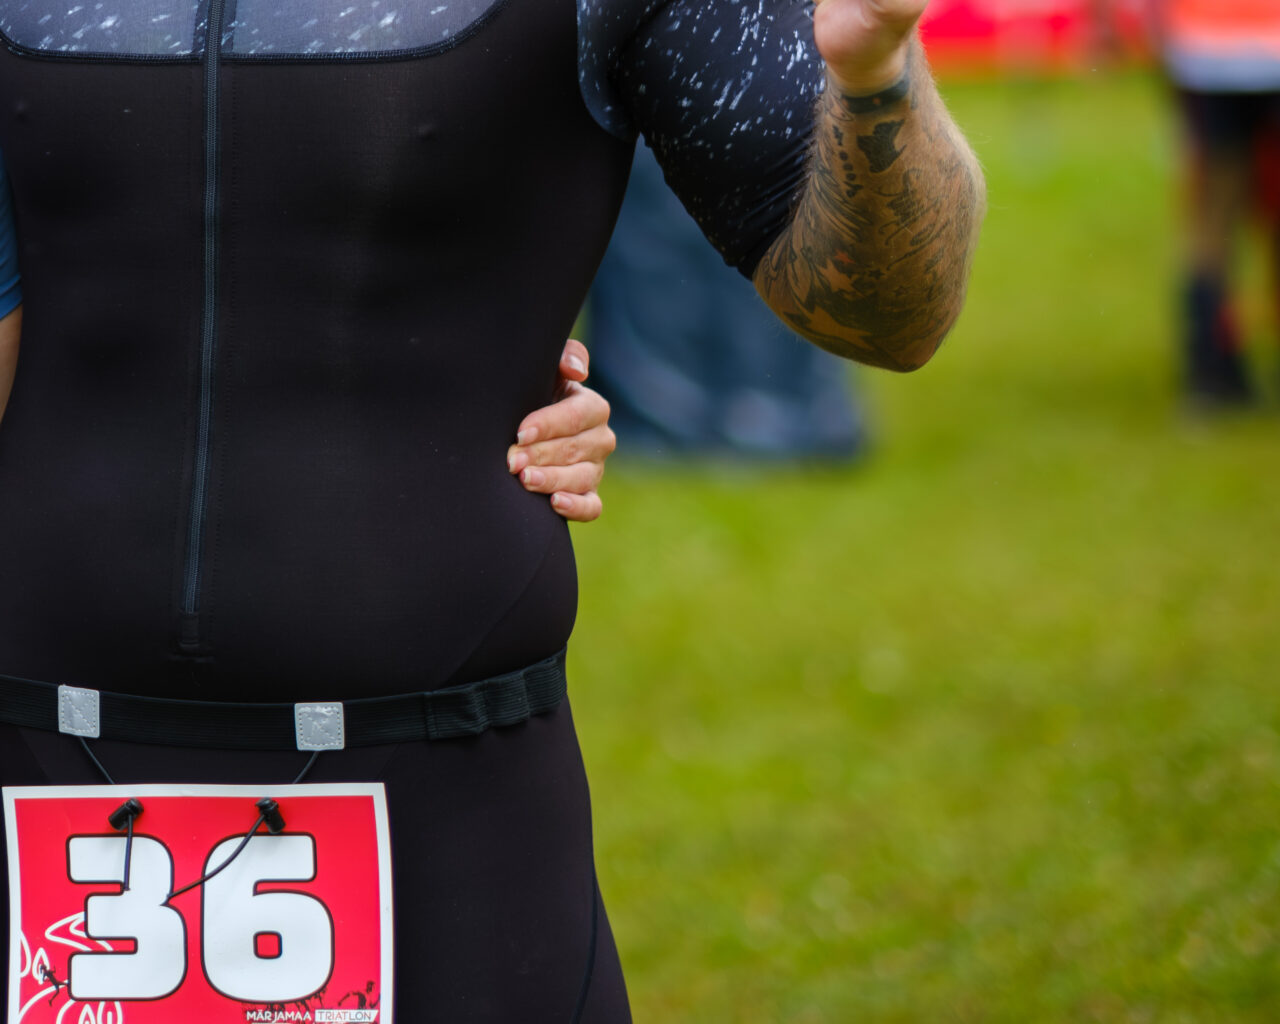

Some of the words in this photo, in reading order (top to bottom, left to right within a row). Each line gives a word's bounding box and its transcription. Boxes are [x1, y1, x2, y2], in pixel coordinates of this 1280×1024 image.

[66, 832, 335, 1004] 36
[246, 1008, 312, 1023] MÄRJAMAA
[317, 1010, 372, 1021] TRIATLON
